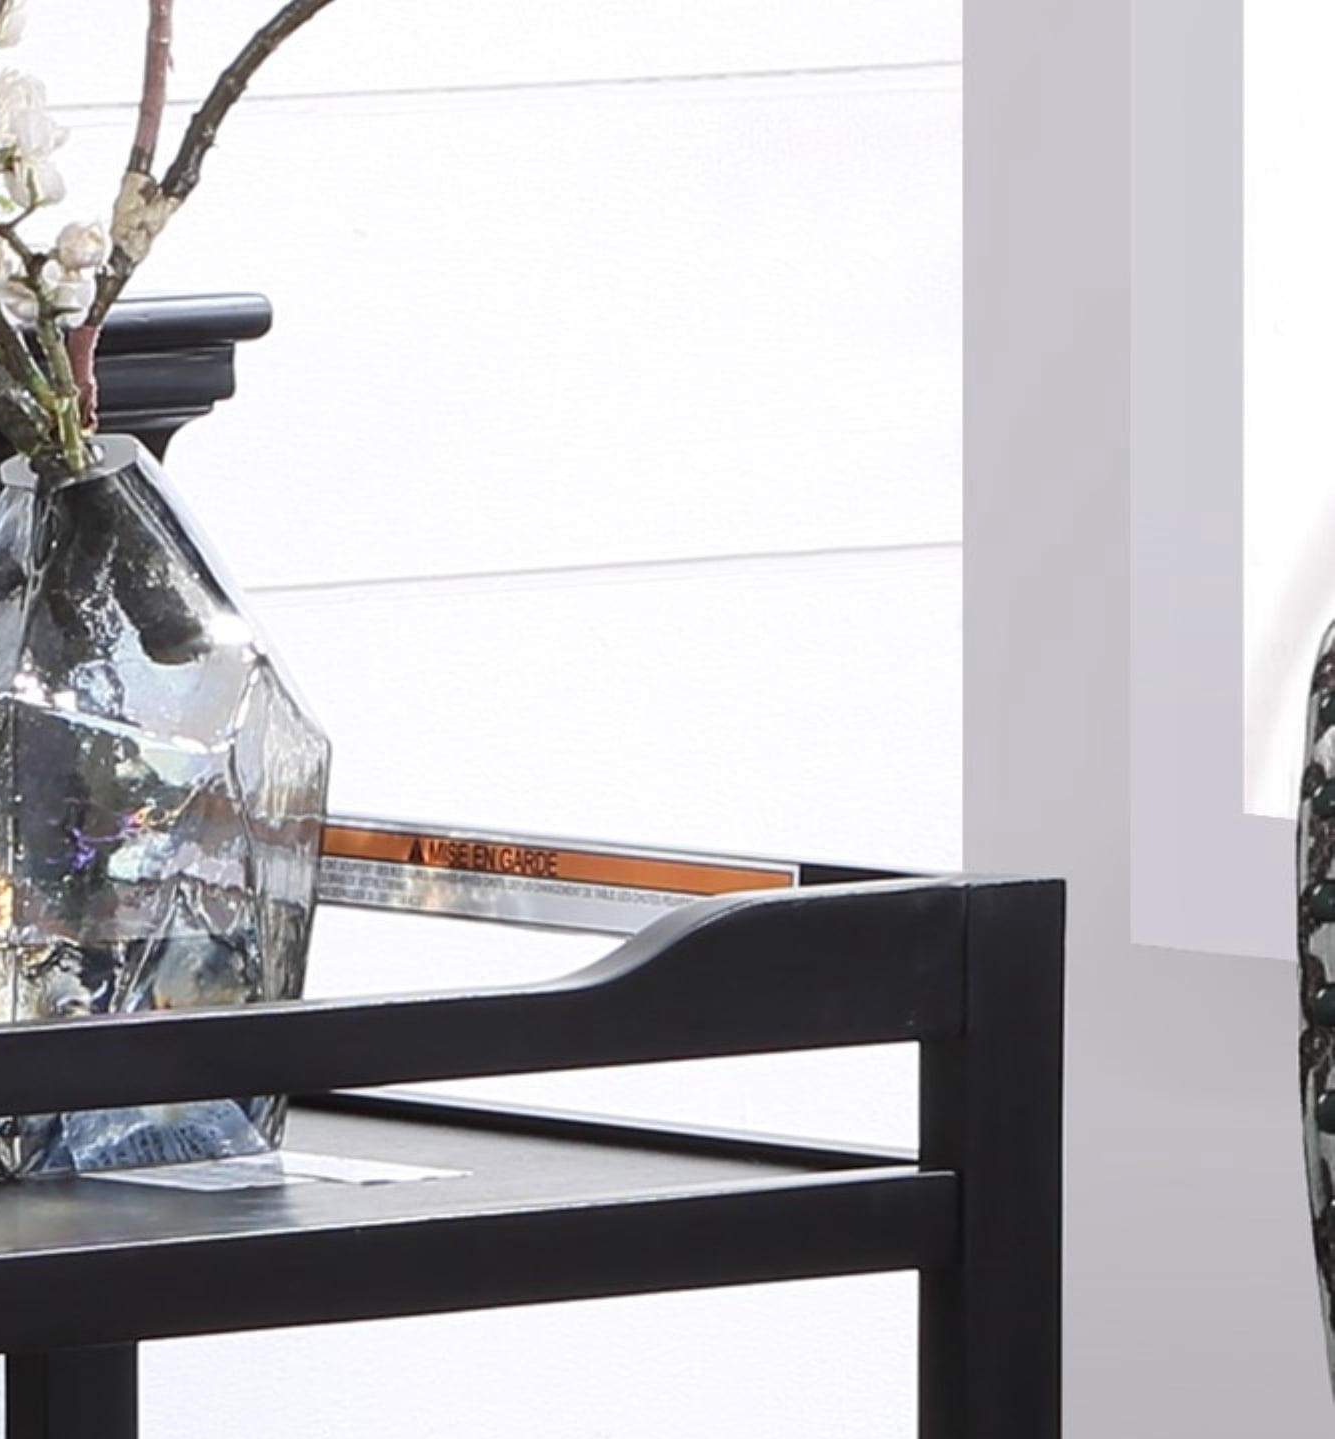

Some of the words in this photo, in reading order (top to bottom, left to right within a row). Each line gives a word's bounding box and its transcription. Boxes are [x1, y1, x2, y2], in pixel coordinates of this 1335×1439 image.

[430, 840, 471, 869] MISE
[473, 845, 497, 872] EN
[500, 848, 558, 877] GARDE
